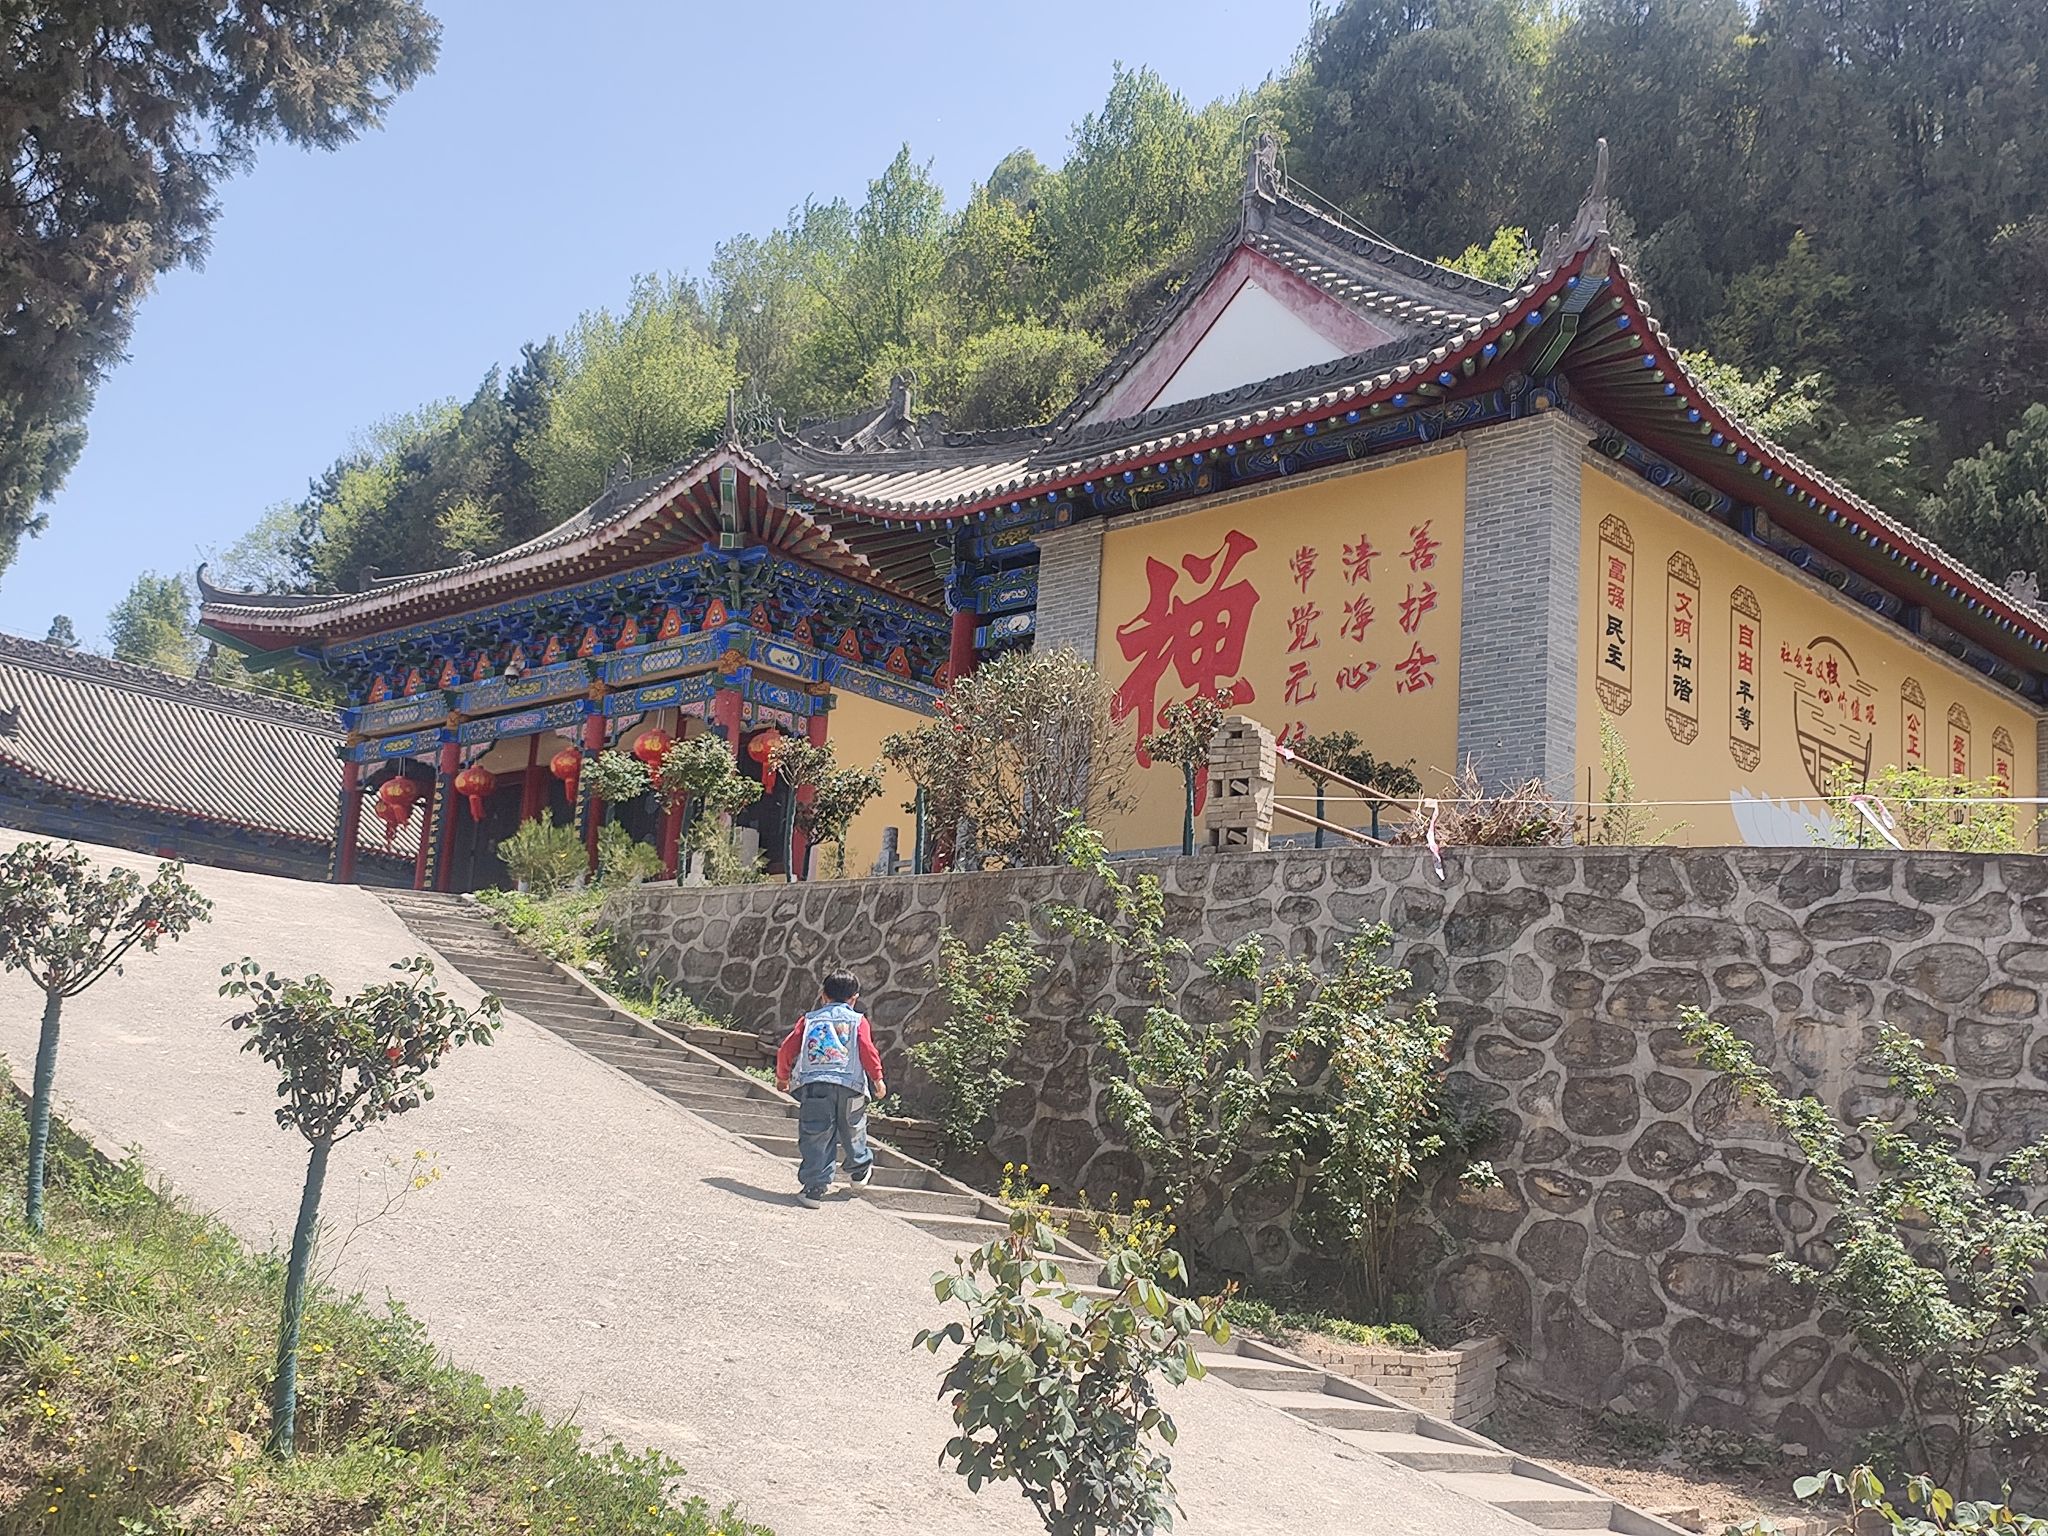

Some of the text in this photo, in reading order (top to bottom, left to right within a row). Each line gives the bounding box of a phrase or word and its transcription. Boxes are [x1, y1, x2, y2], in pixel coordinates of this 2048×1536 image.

[1110, 530, 1260, 816] 禅
[1336, 534, 1381, 691] 清净心
[1394, 520, 1441, 694] 善护念
[1605, 555, 1627, 672] 富强民主
[1672, 592, 1693, 703] 文明和谐
[1736, 624, 1754, 731] 自由平等
